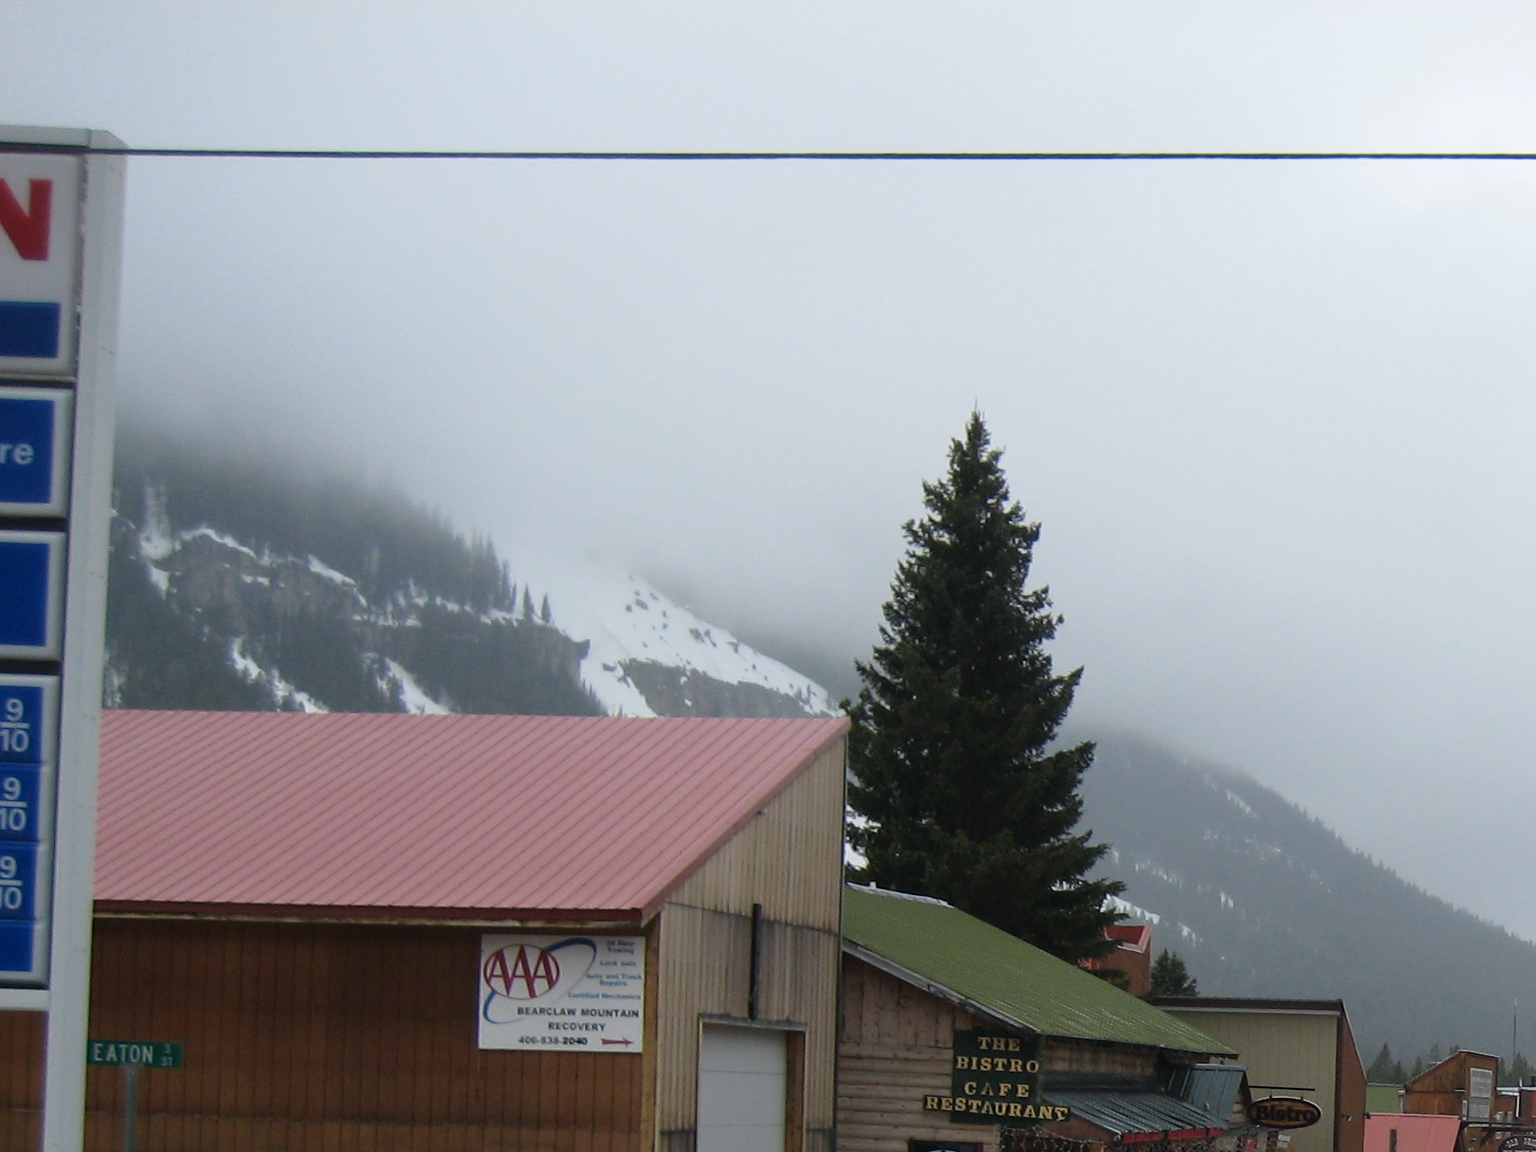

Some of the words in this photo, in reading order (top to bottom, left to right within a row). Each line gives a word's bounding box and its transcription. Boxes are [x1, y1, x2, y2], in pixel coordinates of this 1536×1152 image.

[6, 698, 25, 722] 9
[3, 777, 22, 801] 9
[0, 855, 18, 878] 9
[0, 886, 23, 910] 0
[487, 944, 557, 999] AAA
[517, 1006, 576, 1017] BEARCLAW
[581, 1008, 640, 1019] MOUNTAIN
[548, 1022, 607, 1032] RECOVERY
[93, 1043, 154, 1063] EATON
[978, 1036, 1020, 1052] THE
[955, 1056, 1040, 1074] BISTRO
[963, 1081, 1031, 1098] CAFE
[925, 1095, 1069, 1122] RESTAURANT
[1257, 1105, 1317, 1122] Bistro
